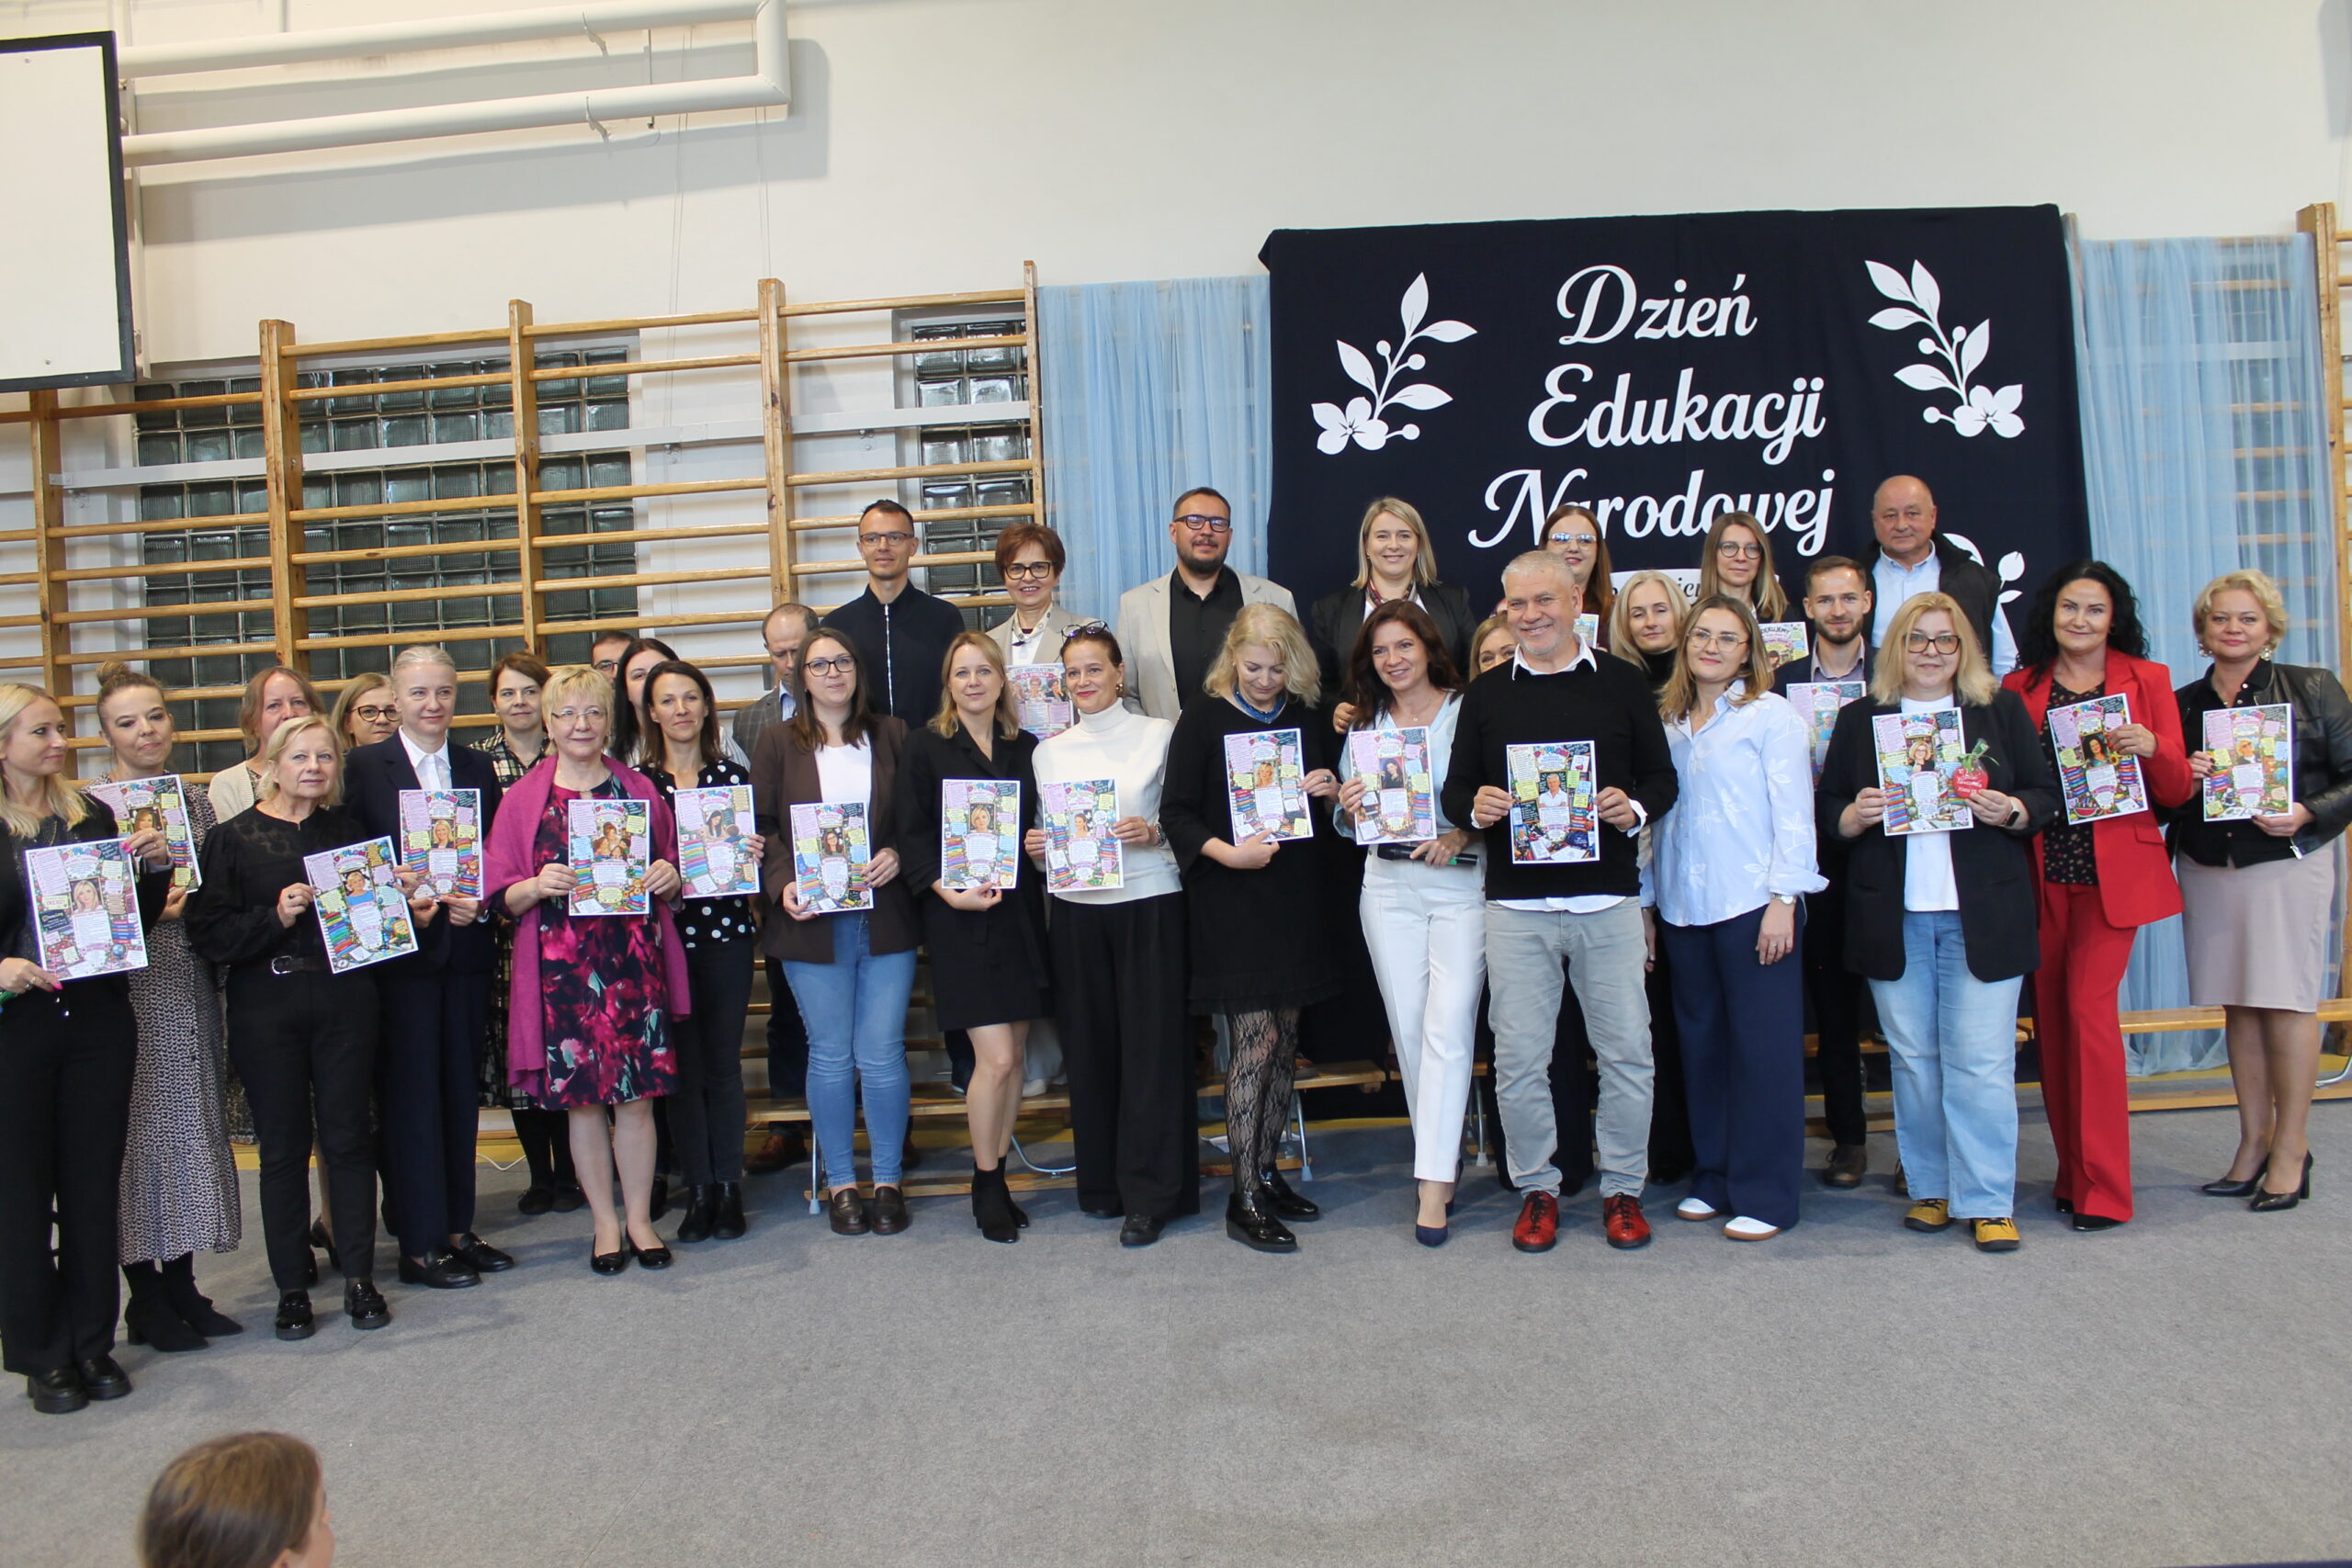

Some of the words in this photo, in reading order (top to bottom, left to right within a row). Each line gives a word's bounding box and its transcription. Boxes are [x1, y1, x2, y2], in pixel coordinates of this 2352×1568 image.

[1556, 265, 1758, 345] Dzień
[1528, 363, 1826, 465] Edukacji
[1468, 468, 1836, 557] Nrodowej
